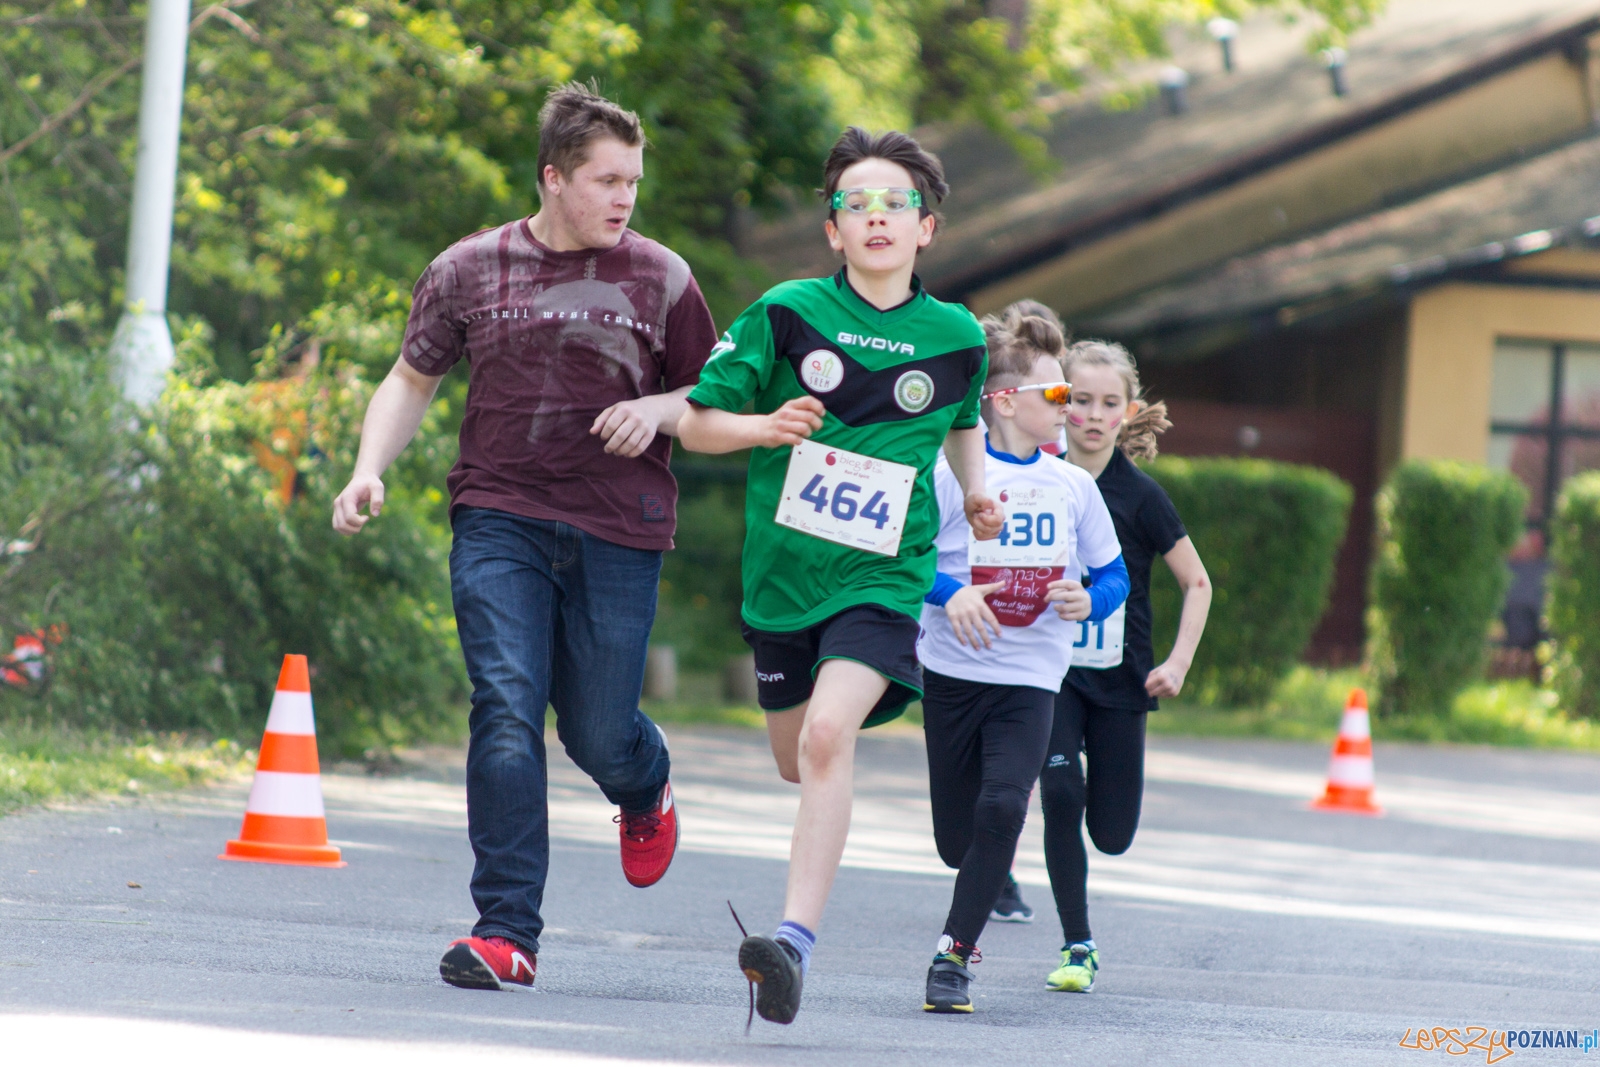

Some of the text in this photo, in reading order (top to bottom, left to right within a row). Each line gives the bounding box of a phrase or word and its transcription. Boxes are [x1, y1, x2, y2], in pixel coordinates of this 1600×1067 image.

[491, 308, 529, 320] bull
[543, 310, 590, 321] west
[604, 313, 652, 333] coast
[836, 331, 916, 357] GIVOVA
[799, 473, 890, 530] 464
[1014, 568, 1035, 582] na
[1013, 580, 1041, 599] tak
[992, 599, 1007, 608] Run
[1016, 602, 1035, 613] Spirit
